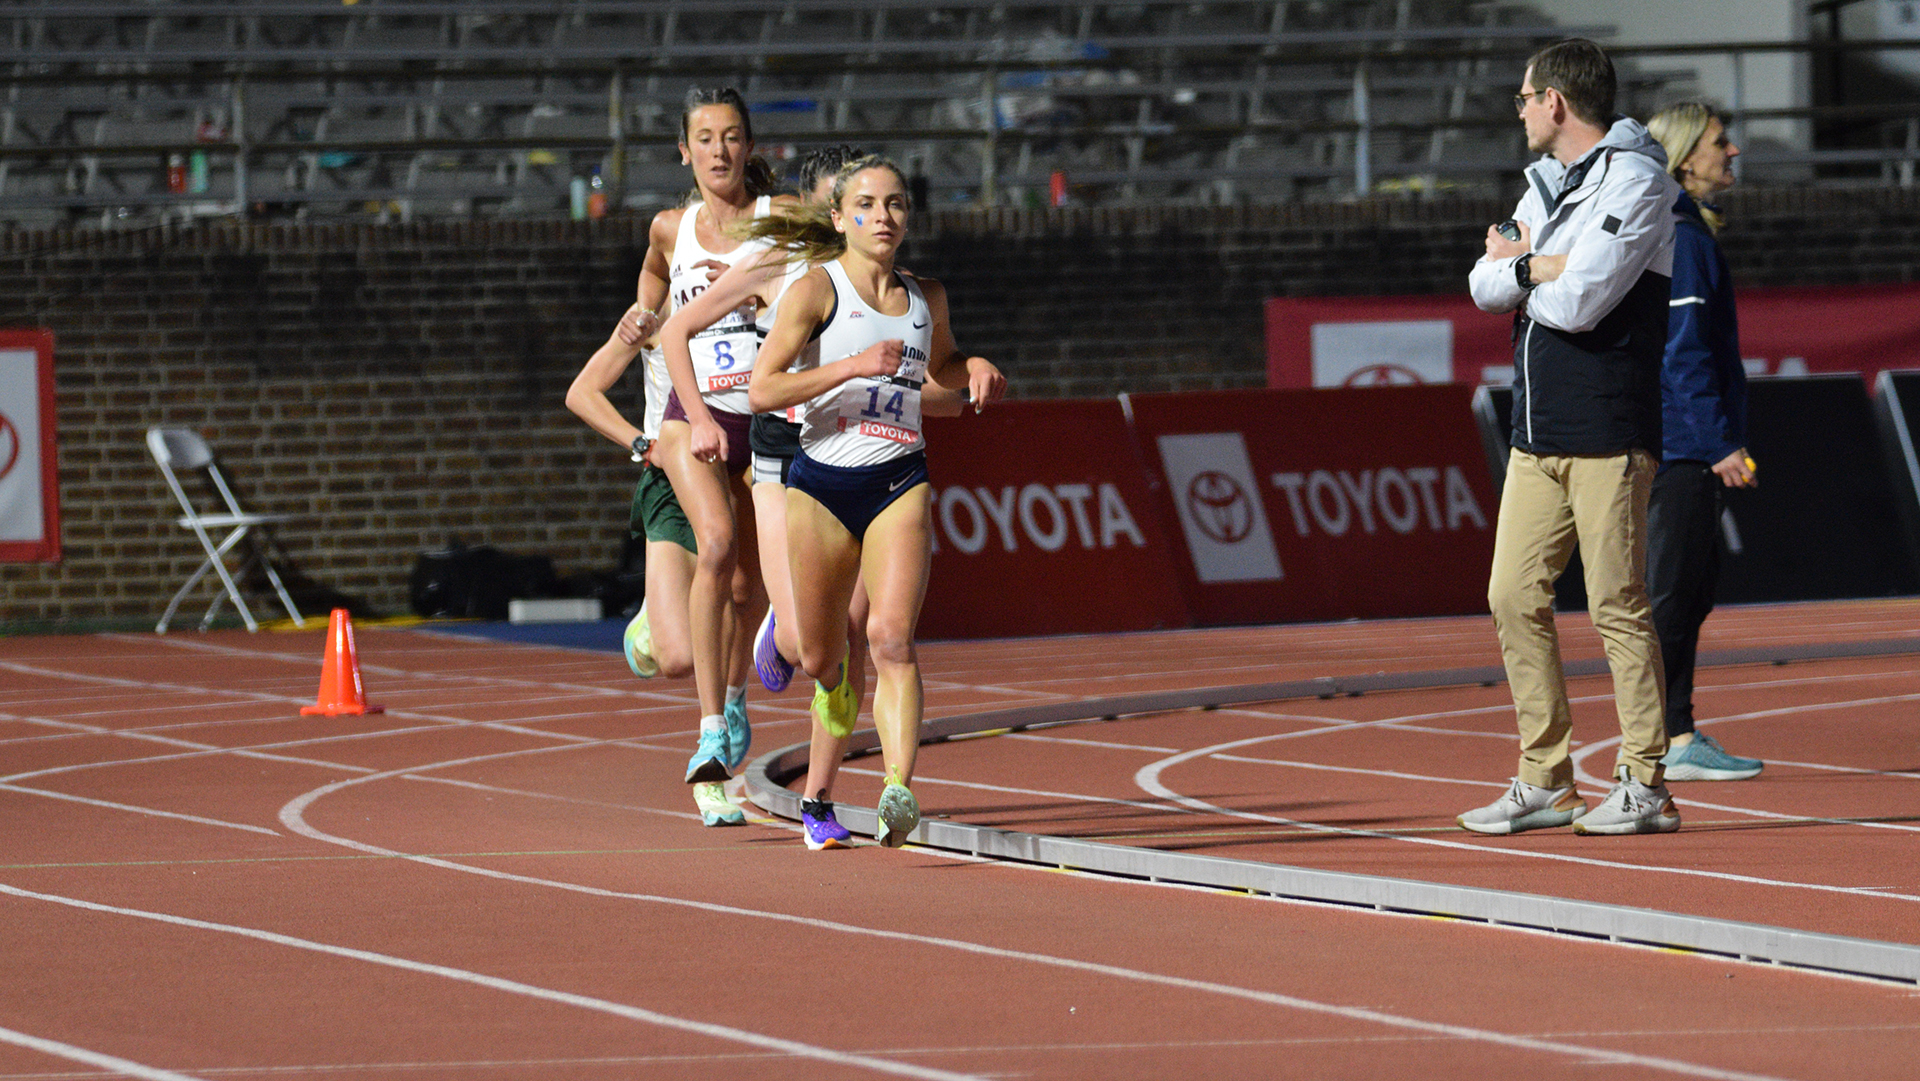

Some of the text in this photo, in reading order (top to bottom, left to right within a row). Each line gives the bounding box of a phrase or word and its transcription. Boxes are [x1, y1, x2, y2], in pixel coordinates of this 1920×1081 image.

[714, 341, 735, 370] 8
[711, 374, 752, 388] TOYOT
[861, 386, 904, 422] 14
[864, 421, 911, 442] TOYOTA
[1271, 466, 1488, 536] TOYOTA
[932, 483, 1144, 553] OYOTA
